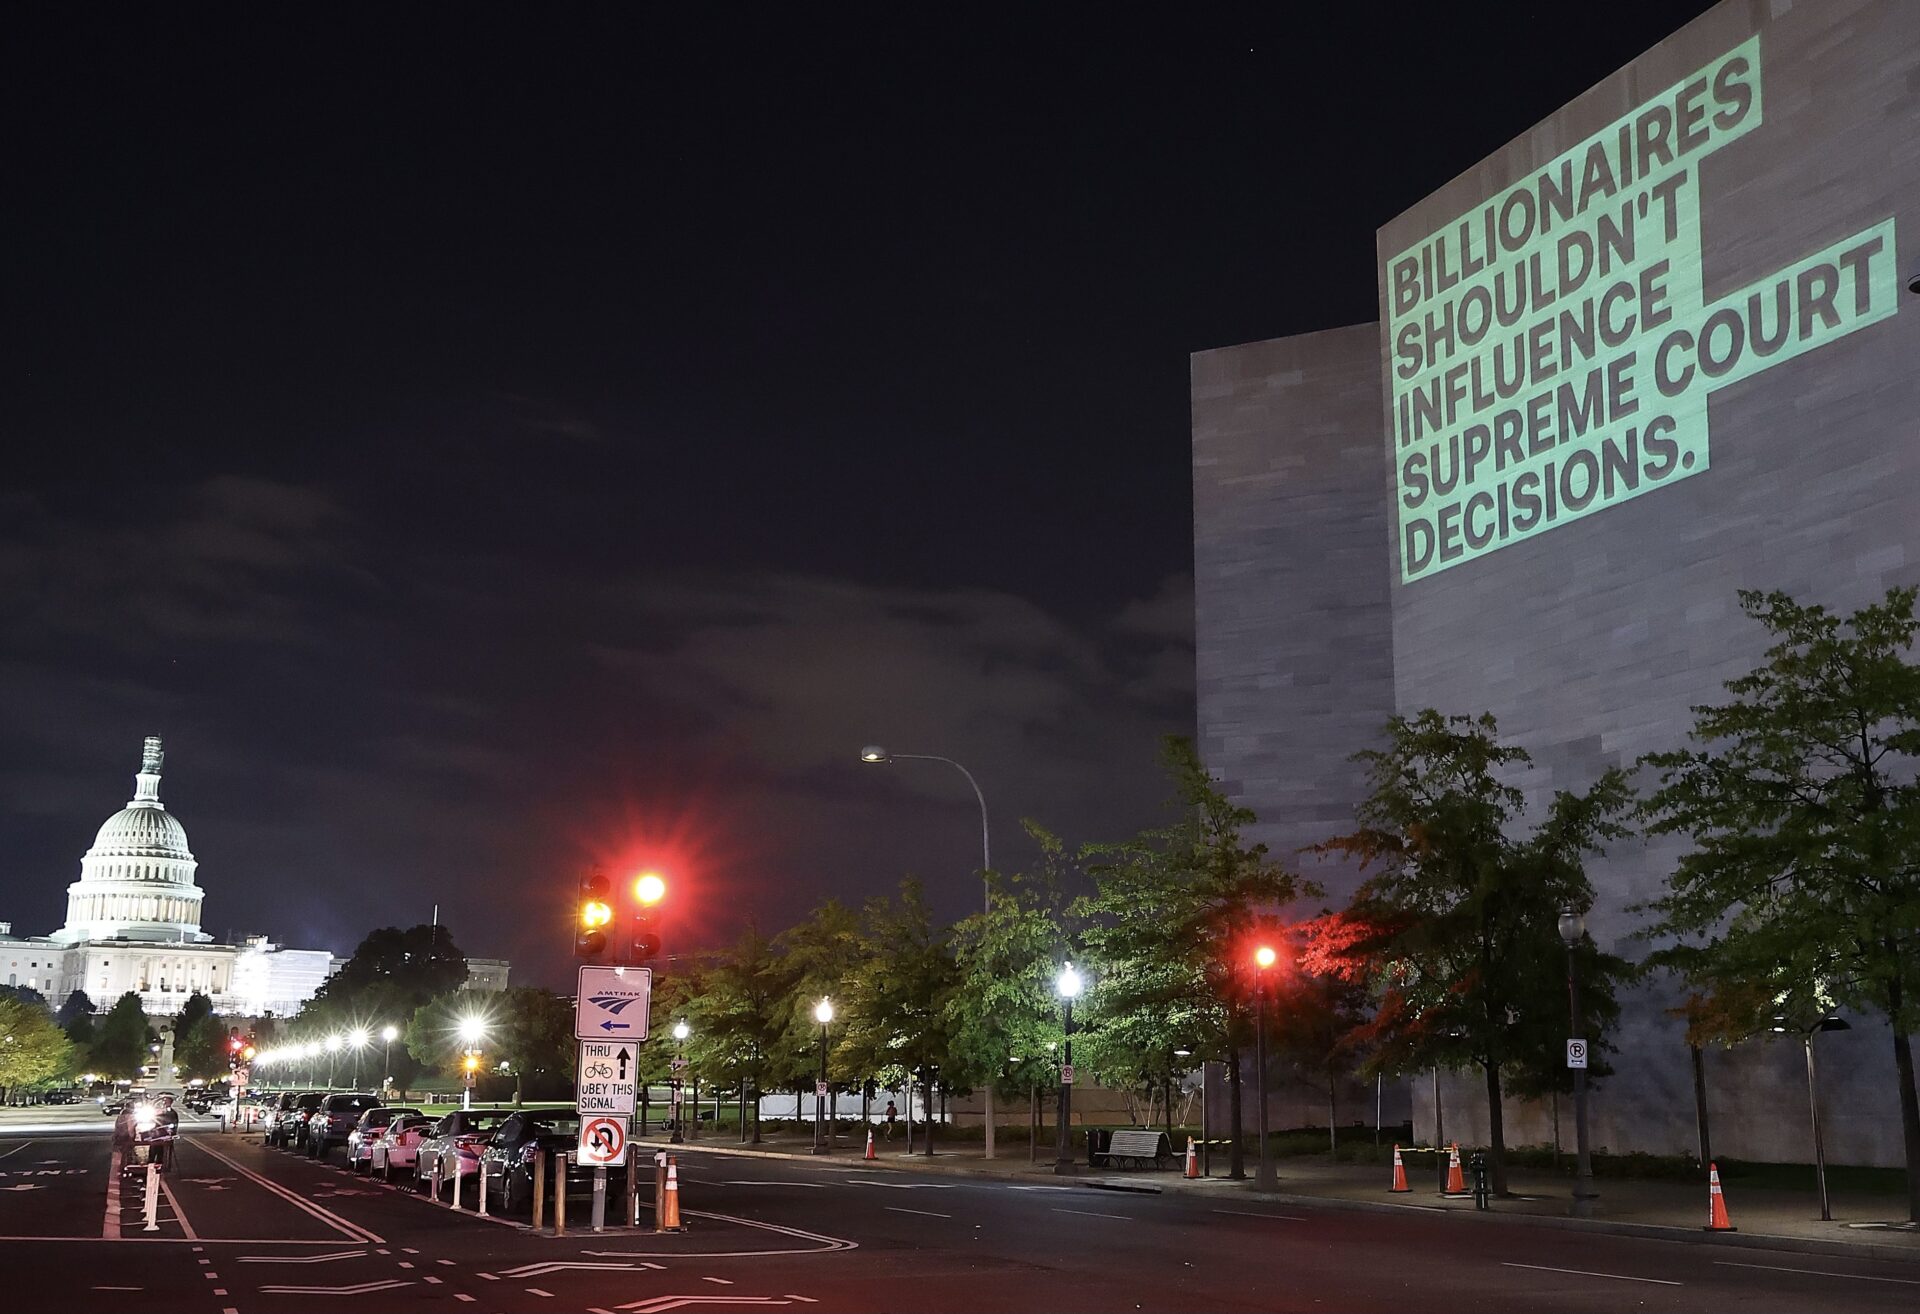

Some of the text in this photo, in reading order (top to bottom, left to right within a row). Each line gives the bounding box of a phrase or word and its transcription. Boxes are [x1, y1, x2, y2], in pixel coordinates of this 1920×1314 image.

[1393, 57, 1752, 318] BILLIONAIRES
[1396, 169, 1688, 380] SHOULDN'T
[1400, 259, 1672, 448] INFLUENCE
[1403, 236, 1884, 509] SUPREME COURT
[1405, 415, 1696, 576] DECISIONS.
[581, 1097, 615, 1109] SIGNAL
[585, 1045, 610, 1057] THRU
[612, 1084, 633, 1095] THIS
